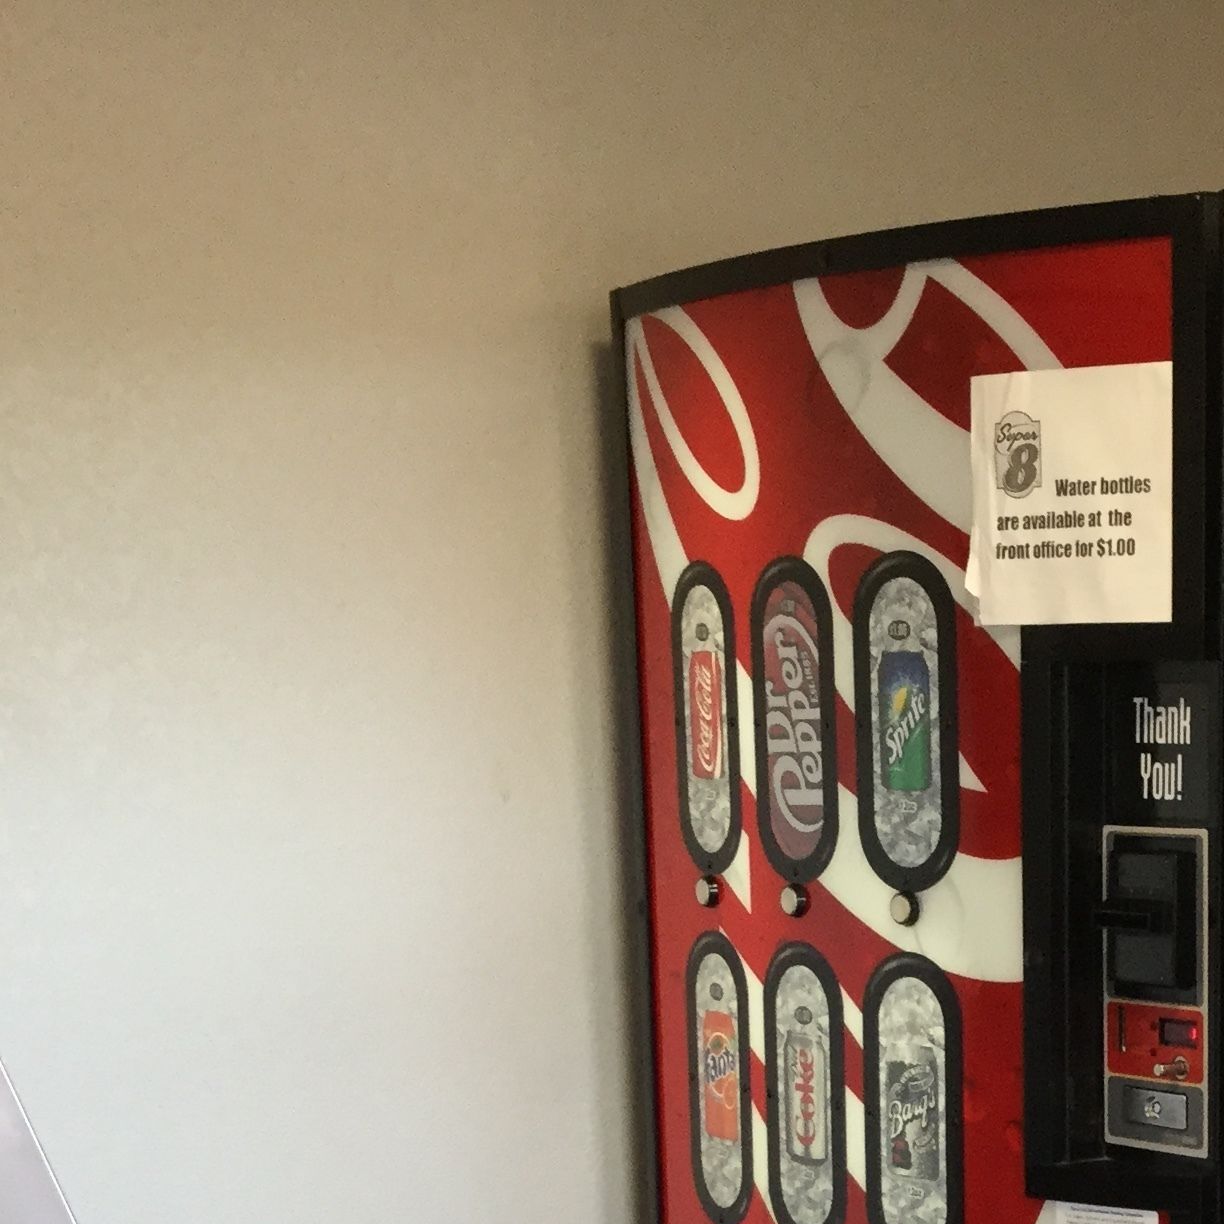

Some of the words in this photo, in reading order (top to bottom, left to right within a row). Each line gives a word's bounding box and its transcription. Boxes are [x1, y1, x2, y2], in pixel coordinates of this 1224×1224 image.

[996, 423, 1039, 452] Super
[1003, 443, 1040, 493] 8
[1055, 479, 1097, 497] Water
[1100, 476, 1152, 495] bottles
[997, 514, 1019, 531] are
[1022, 510, 1085, 530] available
[1088, 511, 1102, 528] at
[1108, 509, 1132, 527] the
[995, 542, 1030, 559] front
[1033, 541, 1072, 558] office
[1075, 540, 1093, 557] for
[1096, 538, 1136, 558] $1.00
[766, 680, 797, 755] Dr
[771, 631, 824, 828] Pepper
[885, 688, 926, 765] Sprite
[1133, 697, 1191, 744] Thank
[1140, 753, 1182, 801] You!
[794, 1048, 816, 1147] Coke
